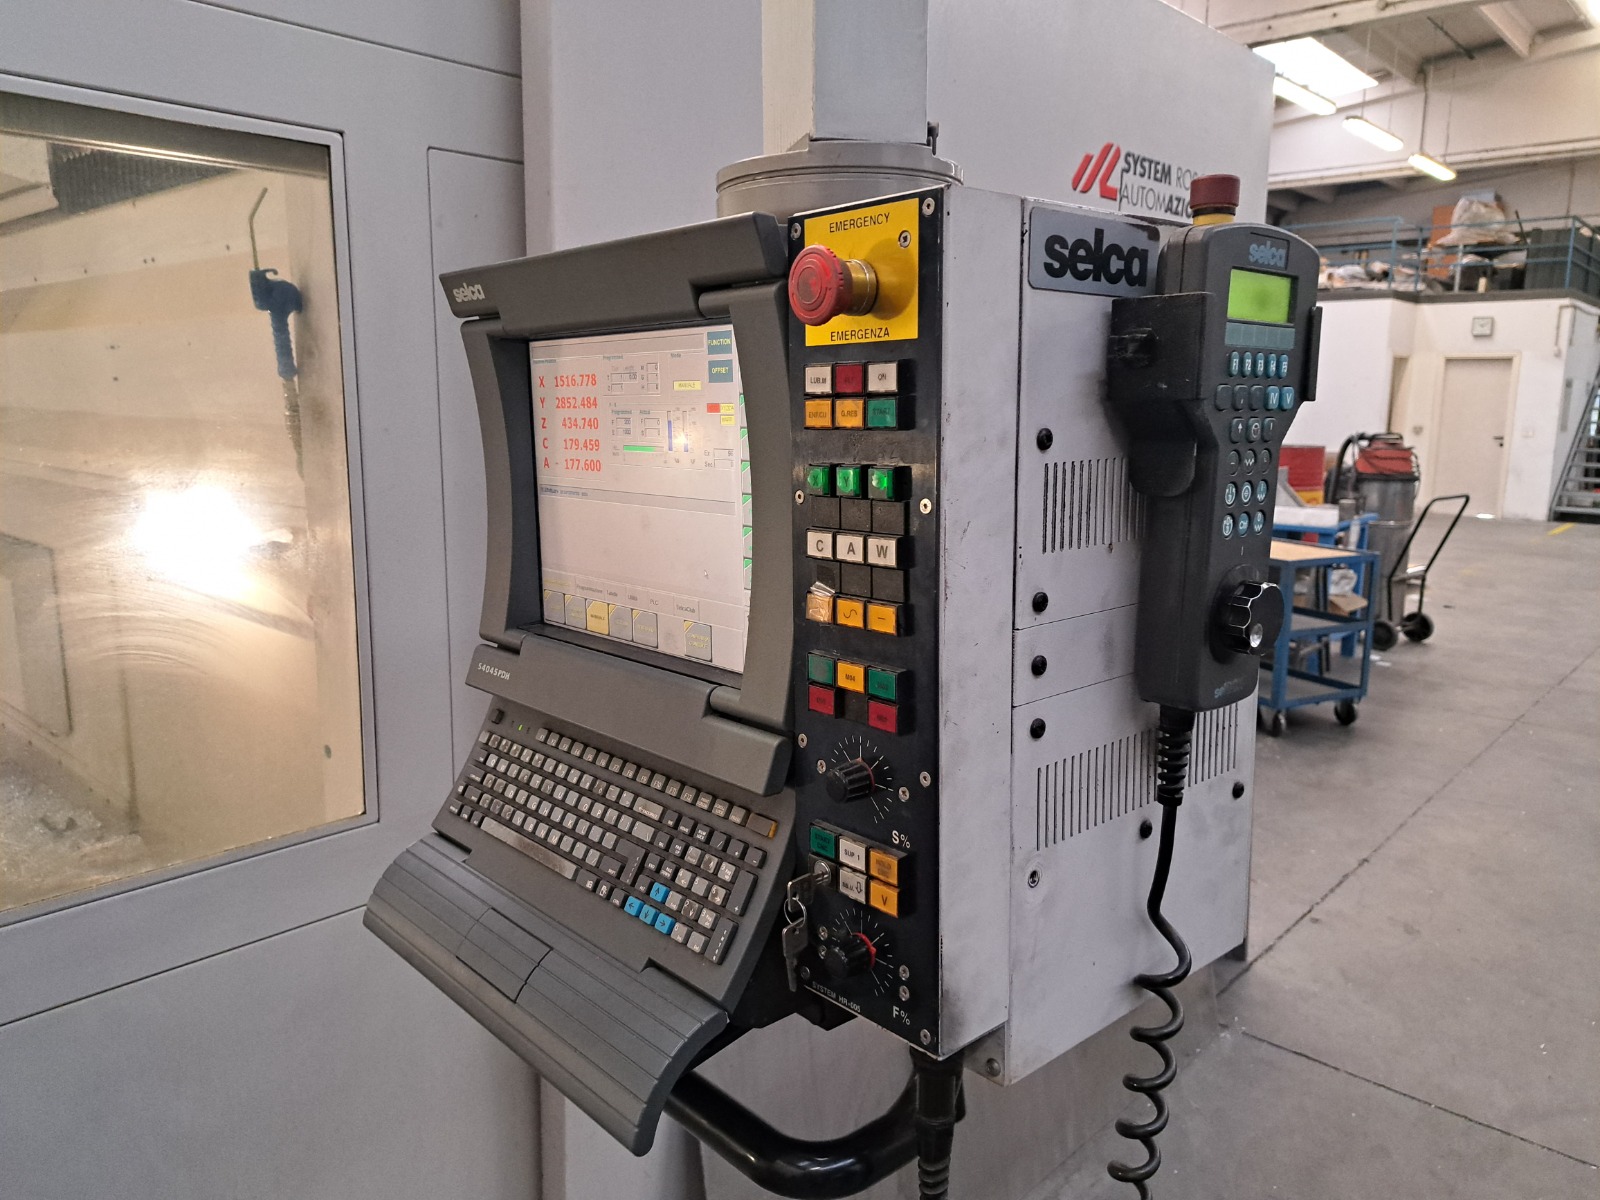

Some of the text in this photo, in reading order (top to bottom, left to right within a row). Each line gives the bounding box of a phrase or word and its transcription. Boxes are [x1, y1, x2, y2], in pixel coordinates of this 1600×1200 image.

[1123, 151, 1172, 186] SYSTEM
[829, 212, 890, 233] EMERGENCY
[1044, 228, 1150, 287] selca
[1249, 241, 1286, 267] selca
[453, 282, 486, 303] selca
[830, 327, 890, 342] EMERGENZA
[708, 338, 732, 346] FUNCTION
[1232, 358, 1239, 370] F1
[1245, 358, 1252, 371] F2
[1257, 359, 1264, 371] F3
[1282, 361, 1288, 373] F5
[539, 373, 597, 388] X 1516.778
[540, 396, 598, 409] Y 2852.484
[1269, 392, 1278, 405] IV
[1286, 393, 1292, 405] V
[541, 417, 599, 430] Z 434.740
[543, 437, 600, 451] C 179.459
[544, 457, 550, 469] A
[565, 458, 601, 471] 177.600
[816, 539, 824, 552] C
[847, 541, 856, 555] A
[876, 544, 888, 559] W
[891, 830, 911, 848] S%
[881, 894, 888, 906] V
[812, 981, 861, 1012] SYSTEM HR-005
[892, 1005, 911, 1026] F%
